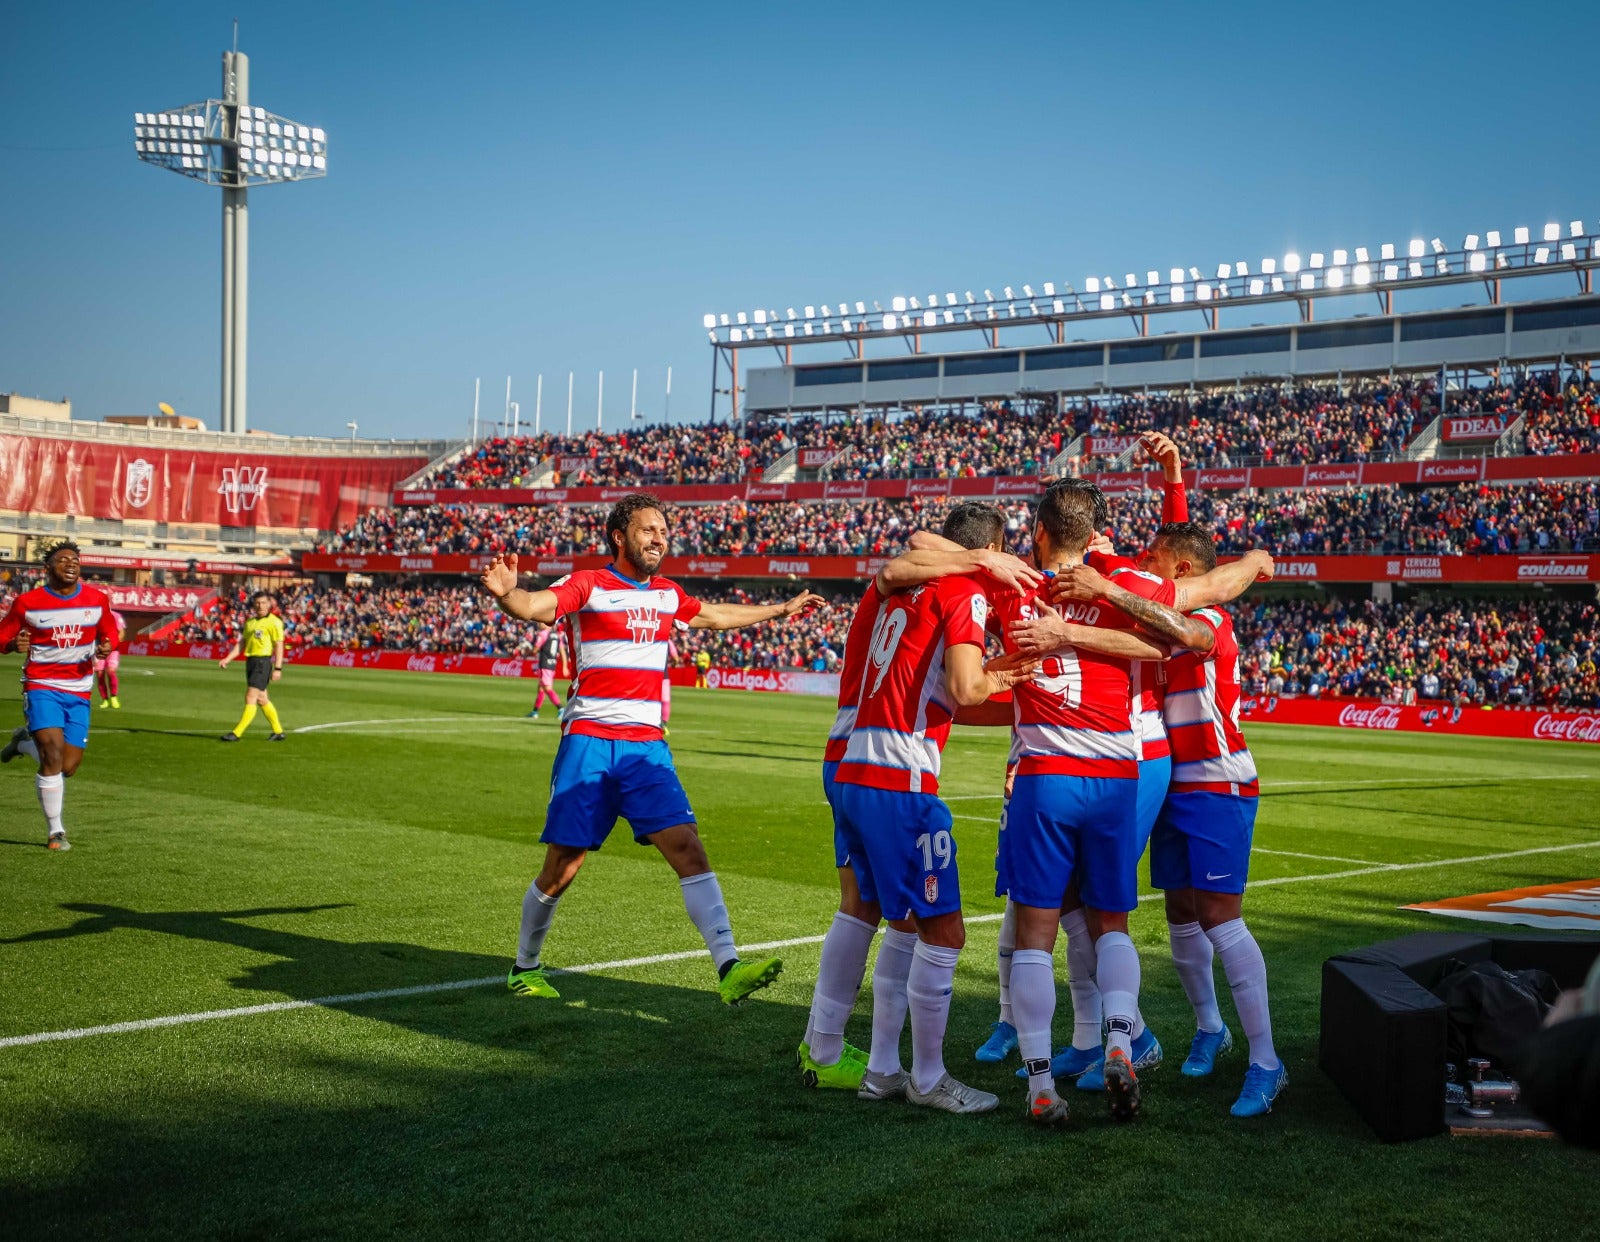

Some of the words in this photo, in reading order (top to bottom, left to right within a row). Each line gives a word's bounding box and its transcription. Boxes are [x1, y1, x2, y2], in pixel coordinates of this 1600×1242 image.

[804, 450, 838, 462] IDEA
[769, 560, 809, 573] PULEVA
[1274, 562, 1317, 576] ULEVA
[1405, 558, 1440, 567] CERVEZAS
[407, 655, 436, 672] Coca-Cola
[491, 659, 523, 677] Coca-Cola
[722, 671, 764, 691] LaLiga
[1031, 645, 1082, 710] 9
[1339, 704, 1403, 729] Coca-Cola
[1533, 713, 1600, 741] Coca-Cola
[916, 829, 952, 872] 19
